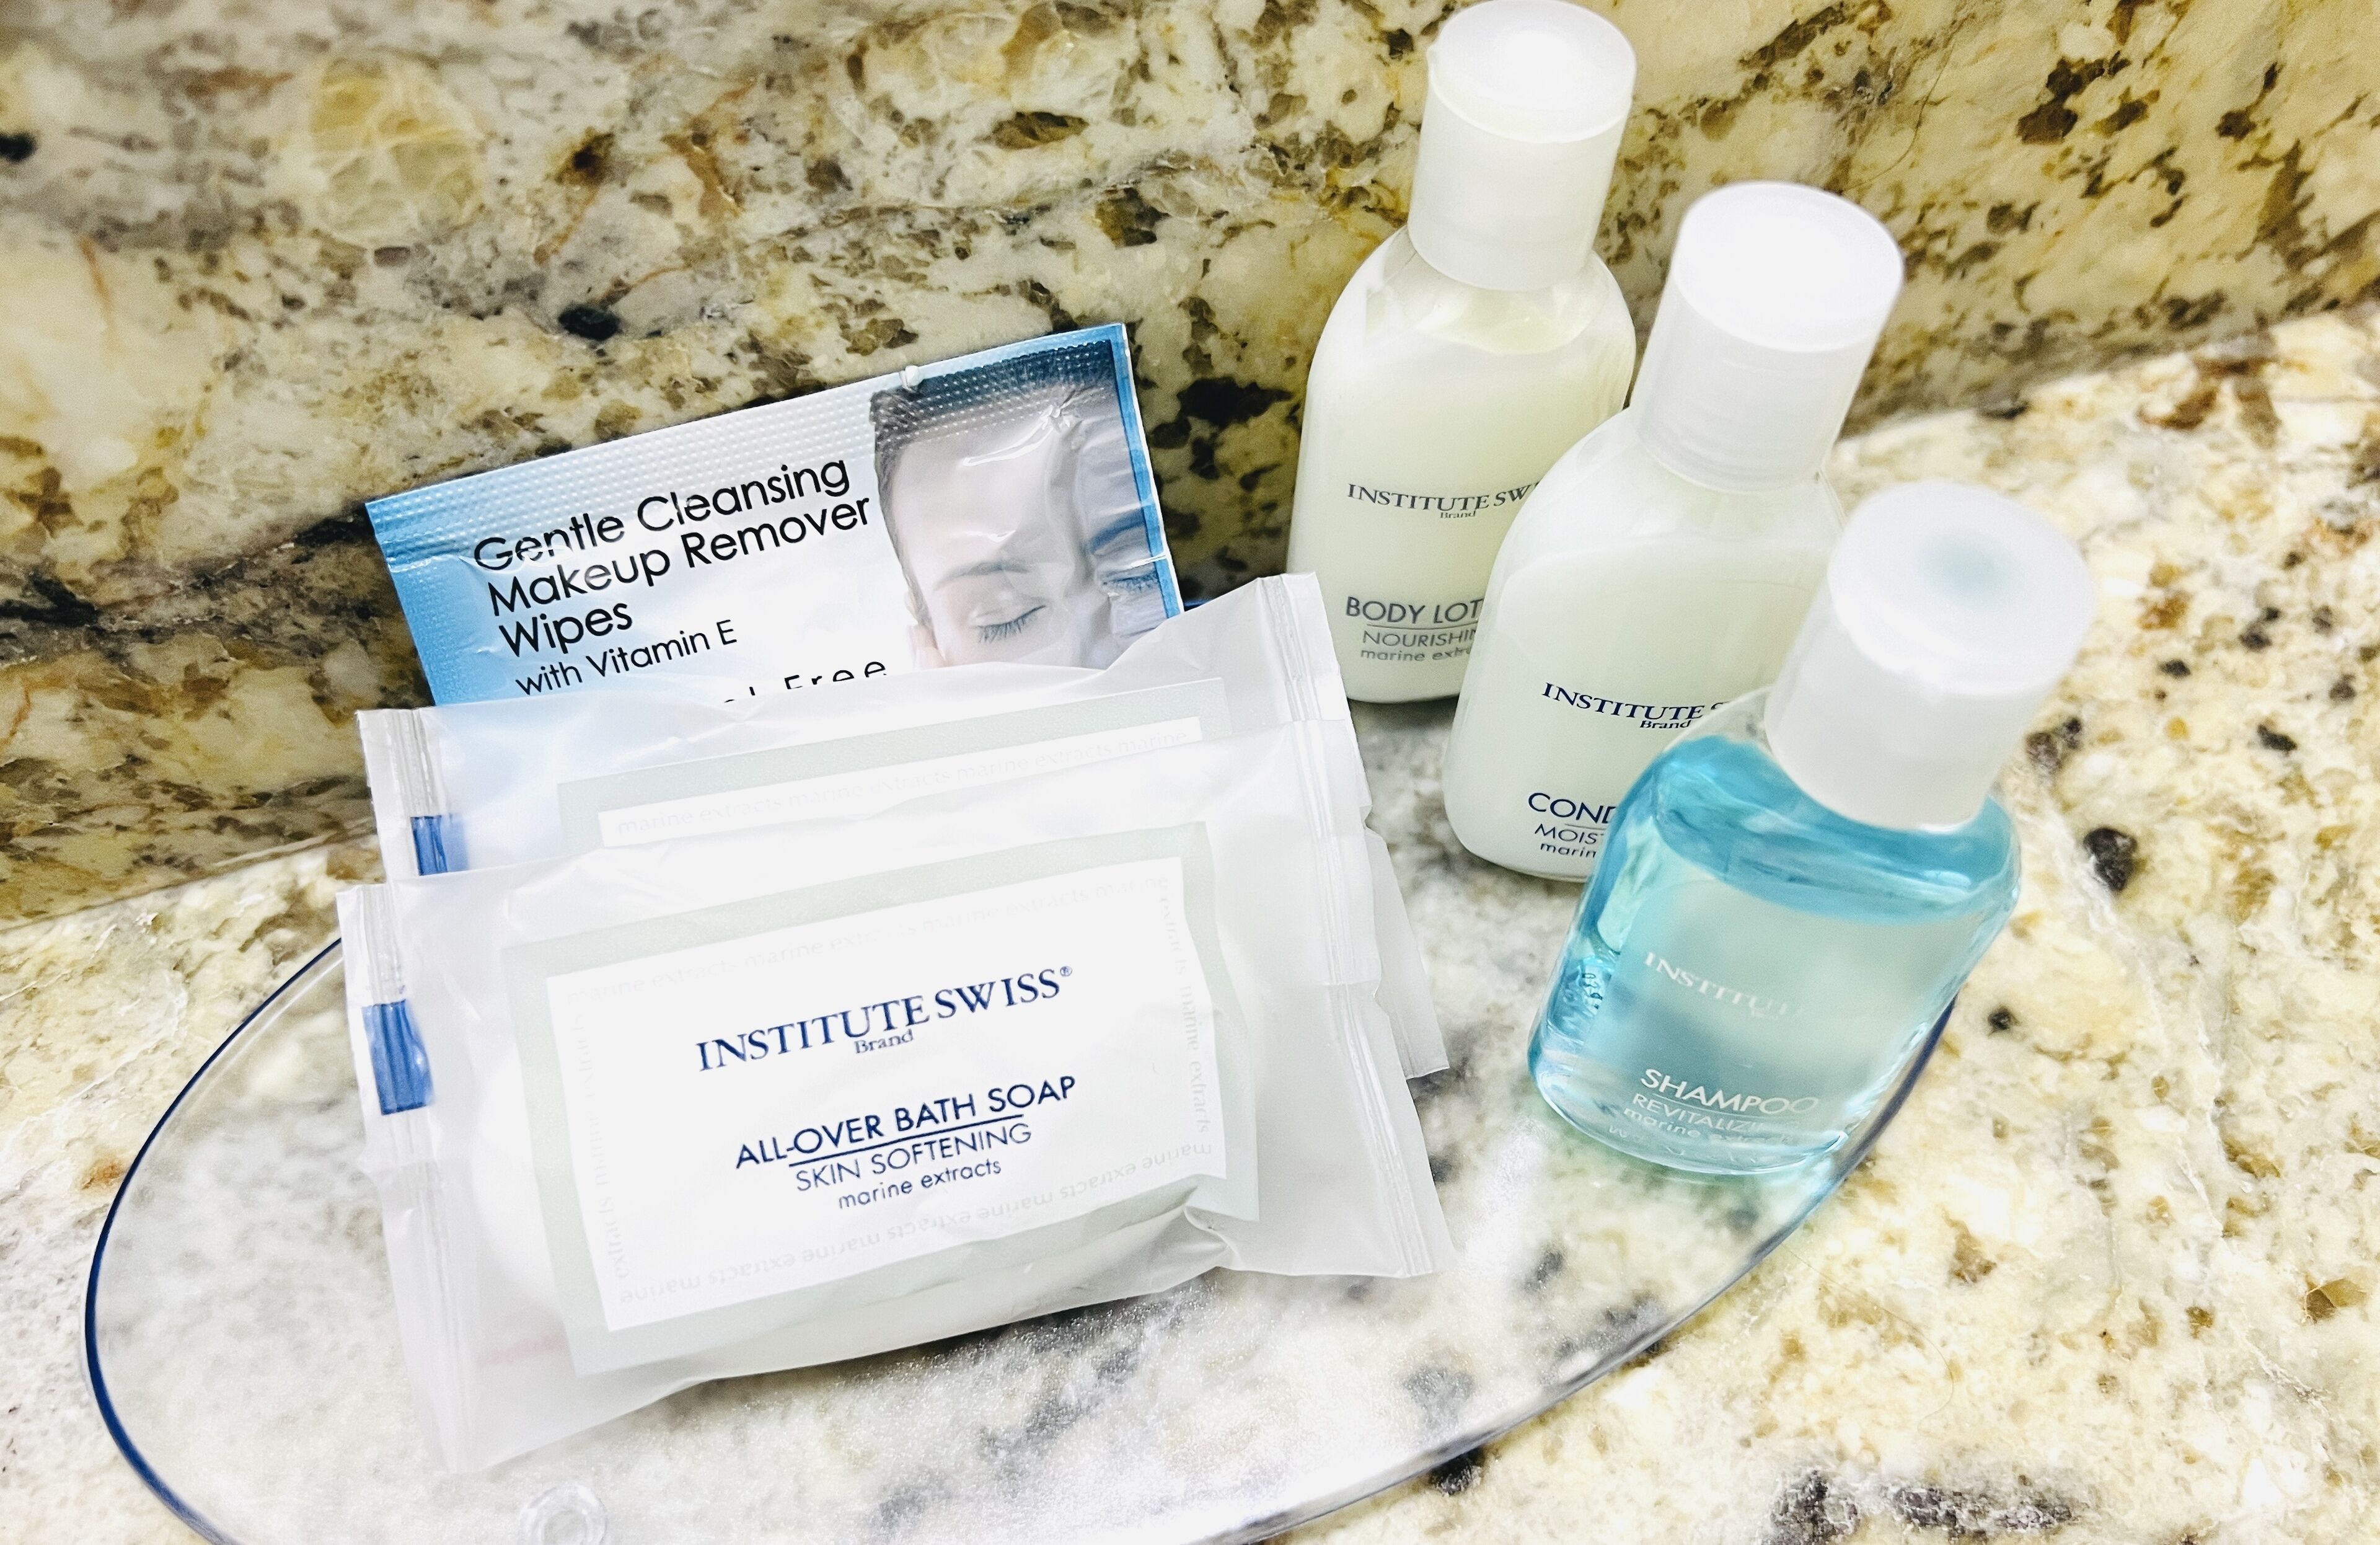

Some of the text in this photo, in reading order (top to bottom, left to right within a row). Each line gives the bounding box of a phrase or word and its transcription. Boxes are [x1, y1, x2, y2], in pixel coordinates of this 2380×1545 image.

[474, 460, 849, 570] Gentle Cleansing
[1347, 482, 1540, 511] INSTITUTE SW
[1440, 510, 1476, 518] Brand
[488, 497, 869, 616] Makeup Remover
[499, 603, 632, 657] Wipes
[1346, 596, 1426, 624] BODY
[516, 619, 737, 695] with Vitamin E
[1360, 649, 1425, 662] marine
[1542, 683, 1704, 720] INSTITUTE
[1640, 720, 1691, 728] Brand
[1535, 824, 1604, 844] MOIS
[696, 994, 930, 1071] INSTITUTE
[855, 1029, 914, 1055] Brand
[1640, 1068, 1819, 1114] SHAMPOO
[736, 1076, 1077, 1169] ALL-OVER BATH SOAP
[796, 1123, 1032, 1192] SKIN SOFTENING
[839, 1159, 1002, 1209] marine extracts
